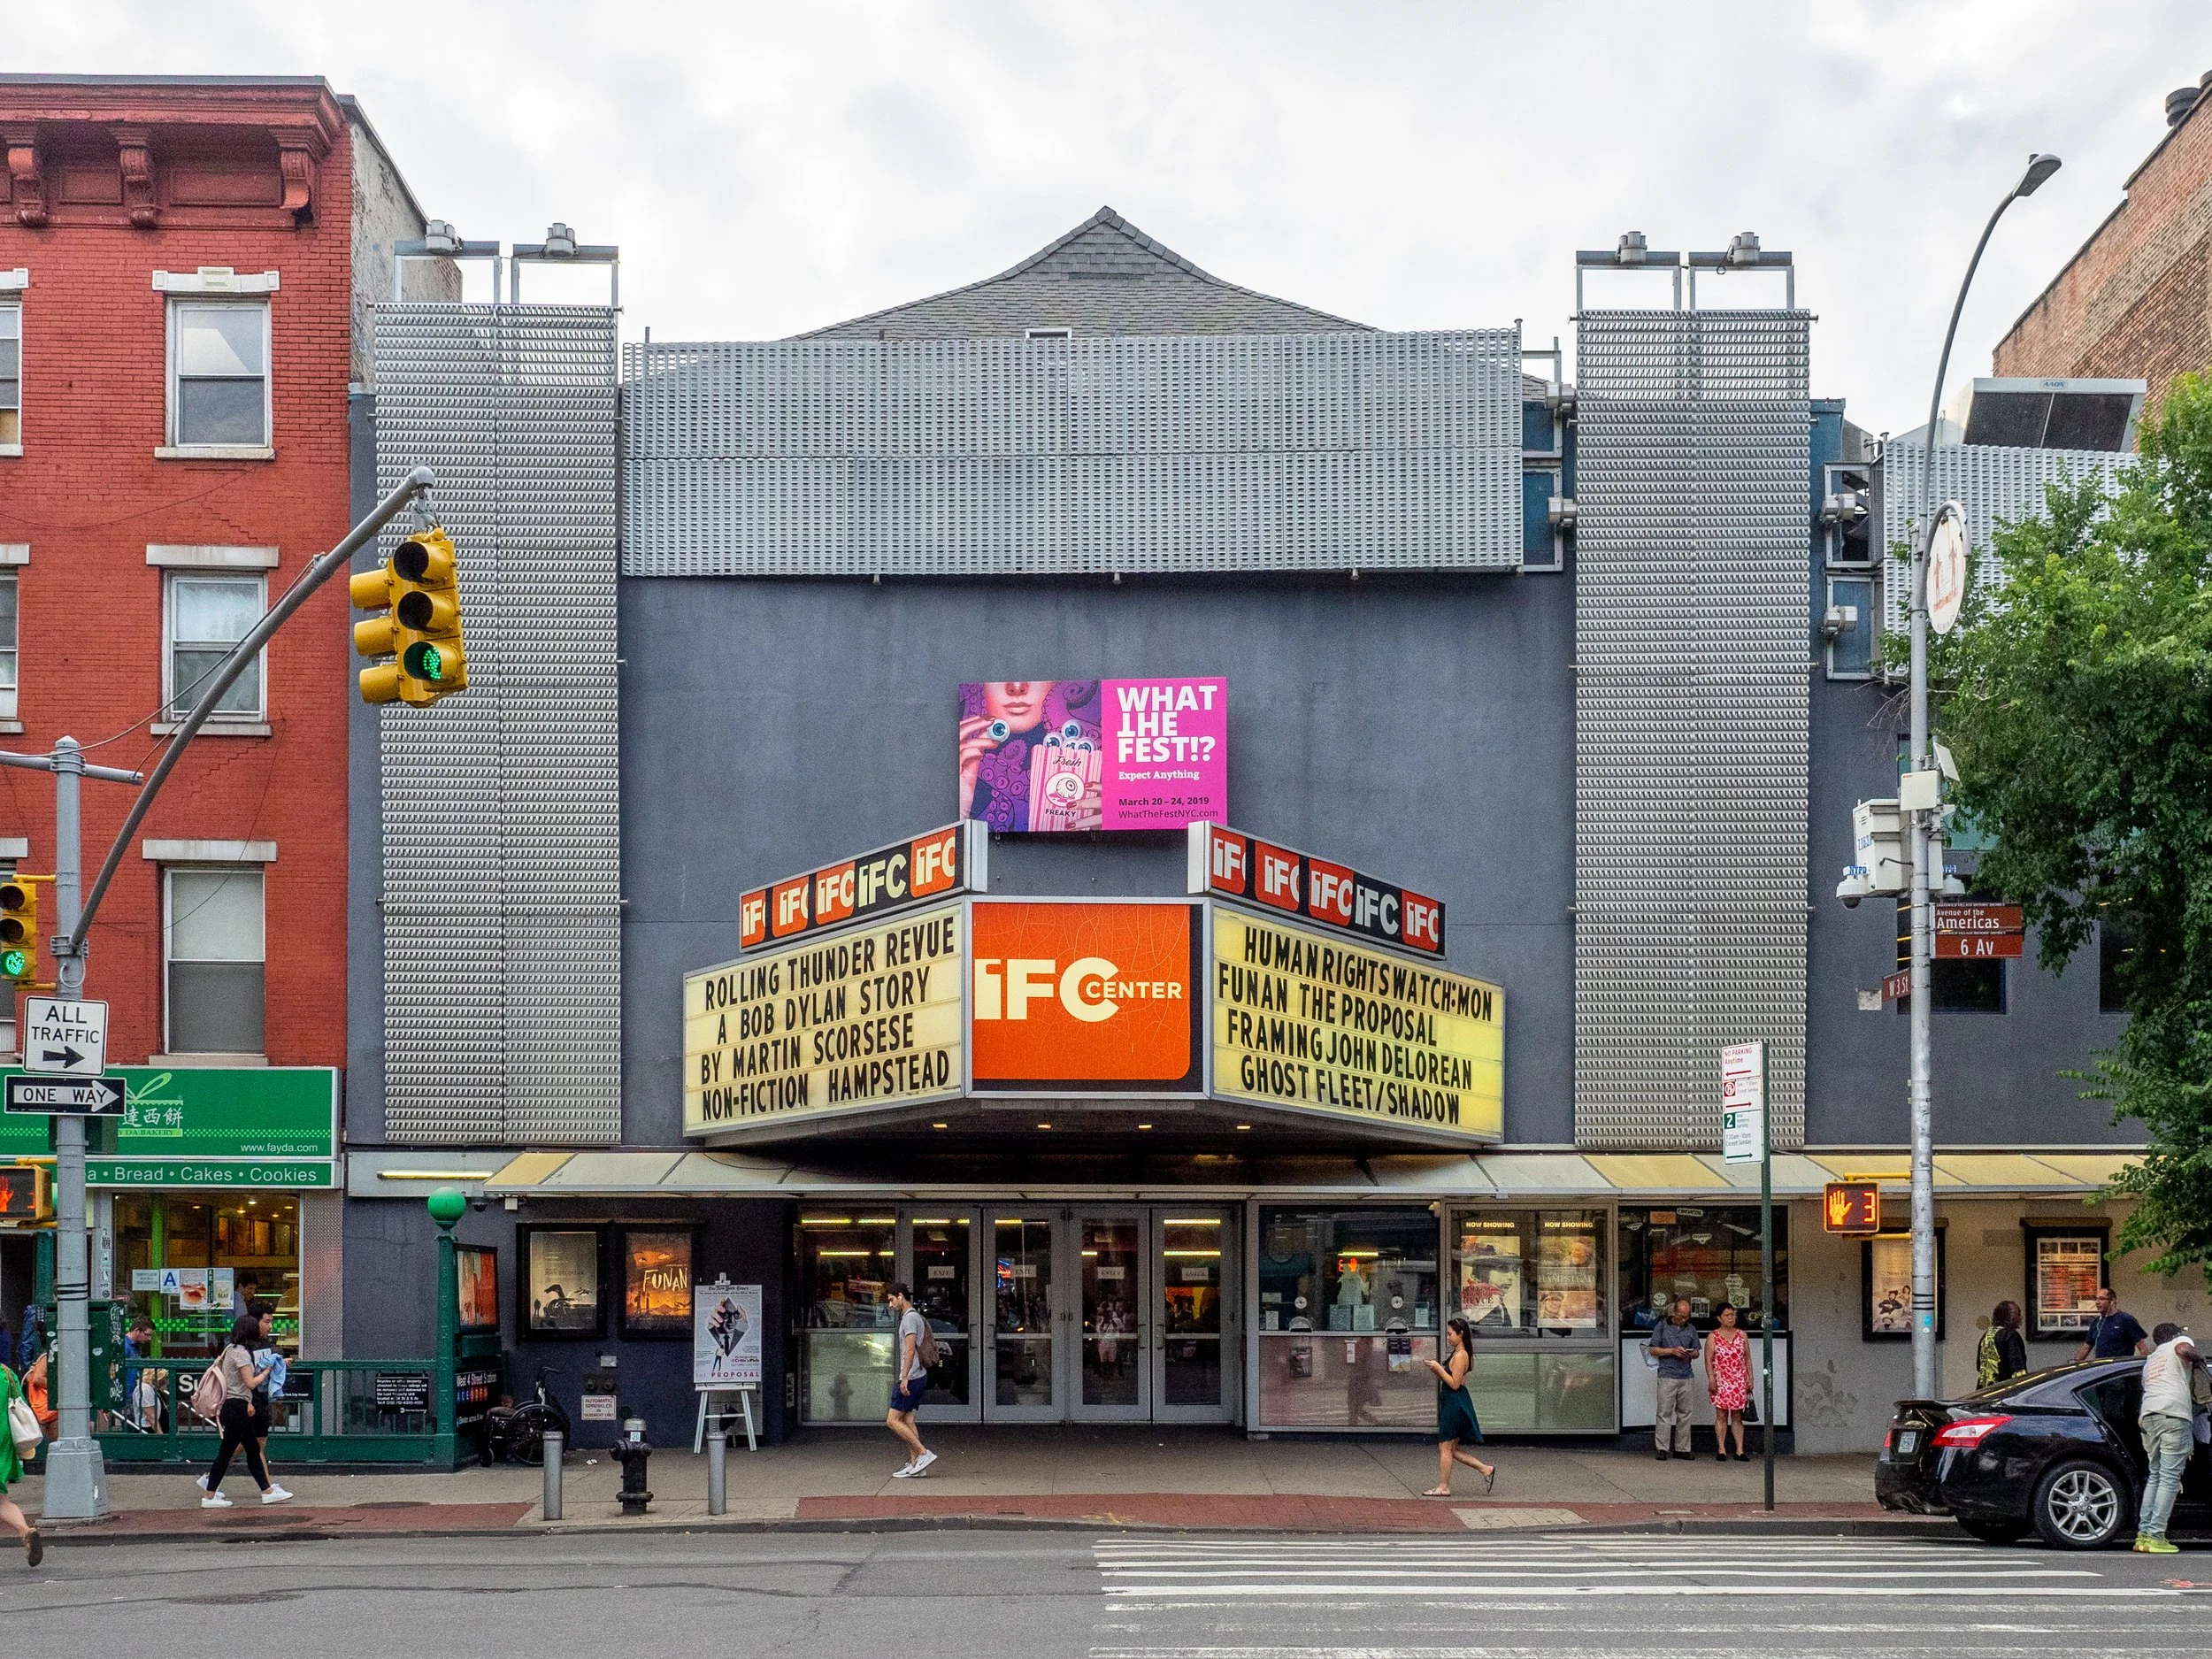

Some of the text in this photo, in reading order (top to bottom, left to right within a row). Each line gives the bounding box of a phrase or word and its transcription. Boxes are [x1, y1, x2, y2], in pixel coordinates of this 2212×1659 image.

[1117, 685, 1217, 711] WHAT
[1117, 711, 1178, 737] THE
[1118, 736, 1215, 763] FEST!?
[1053, 756, 1082, 767] Fresh
[1118, 769, 1200, 780] Expect Anything
[1119, 796, 1209, 807] March 20 24, 2019
[1045, 808, 1076, 818] FREAKY
[1119, 809, 1218, 819] WhatTheFestNYC.com
[1937, 916, 1999, 929] Americas
[1961, 939, 1994, 956] 6 Av
[706, 917, 954, 1010] ROLLING THUNDER REVUE
[1245, 926, 1317, 979] HUMAN
[1323, 952, 1389, 1000] RIGHTS
[1086, 982, 1182, 999] CENTER
[1889, 976, 1909, 997] W 3 St
[718, 966, 931, 1045] A BOB DYLAN STORY
[1219, 962, 1438, 1047] FUNAN THE PROPOSAL
[45, 1005, 88, 1025] ALL
[31, 1026, 100, 1044] TRAFFIC
[702, 1012, 913, 1085] BY MARTIN SCORSESE
[1227, 1009, 1472, 1091] FRAMING JOHN DELOREAN
[703, 1050, 949, 1121] NON-FICTION HAMPSTEAD
[1240, 1055, 1310, 1099] GHOST
[23, 1087, 108, 1103] ONE WAY
[118, 1105, 183, 1128] 達西餅
[1726, 1114, 1733, 1128] 2
[241, 1142, 319, 1154] www.fayda.com
[115, 1167, 164, 1181] Bread
[180, 1167, 233, 1181] Cakes
[250, 1168, 317, 1182] Cookies
[1864, 1192, 1876, 1222] 3
[164, 1272, 176, 1286] A
[643, 1267, 687, 1292] FUNAN
[457, 1375, 466, 1386] West
